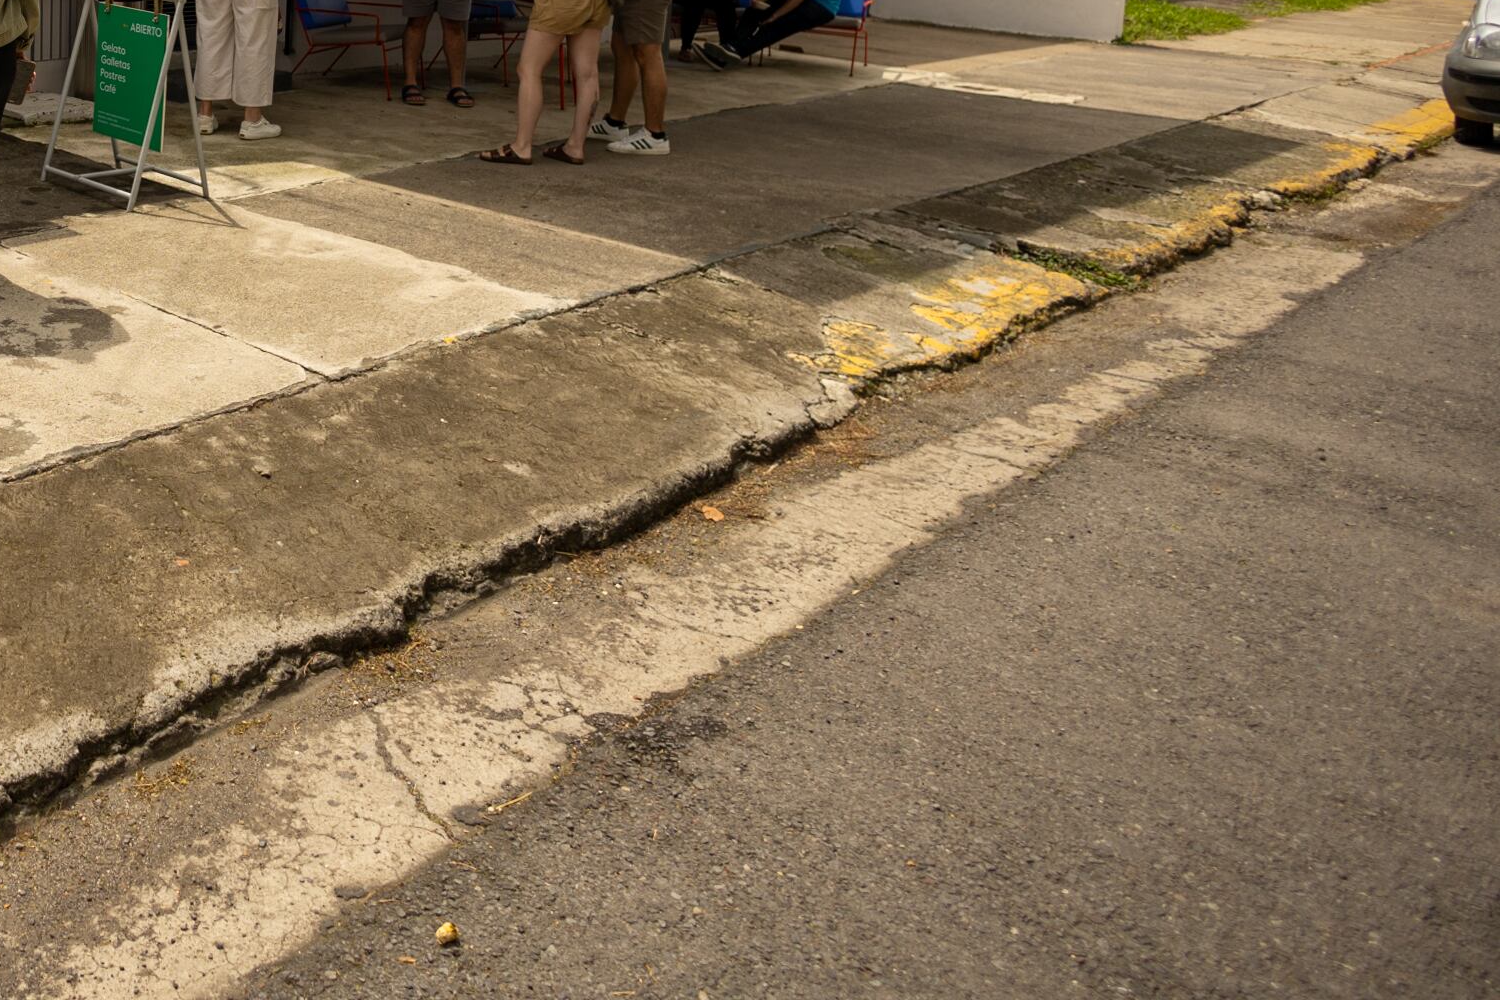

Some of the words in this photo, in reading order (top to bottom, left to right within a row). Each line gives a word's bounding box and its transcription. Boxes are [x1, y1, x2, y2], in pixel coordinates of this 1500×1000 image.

[130, 23, 162, 37] ABIERTO
[101, 41, 126, 55] Gelato
[101, 55, 131, 70] Galletas
[100, 68, 126, 83] Postres
[100, 82, 117, 93] Café
